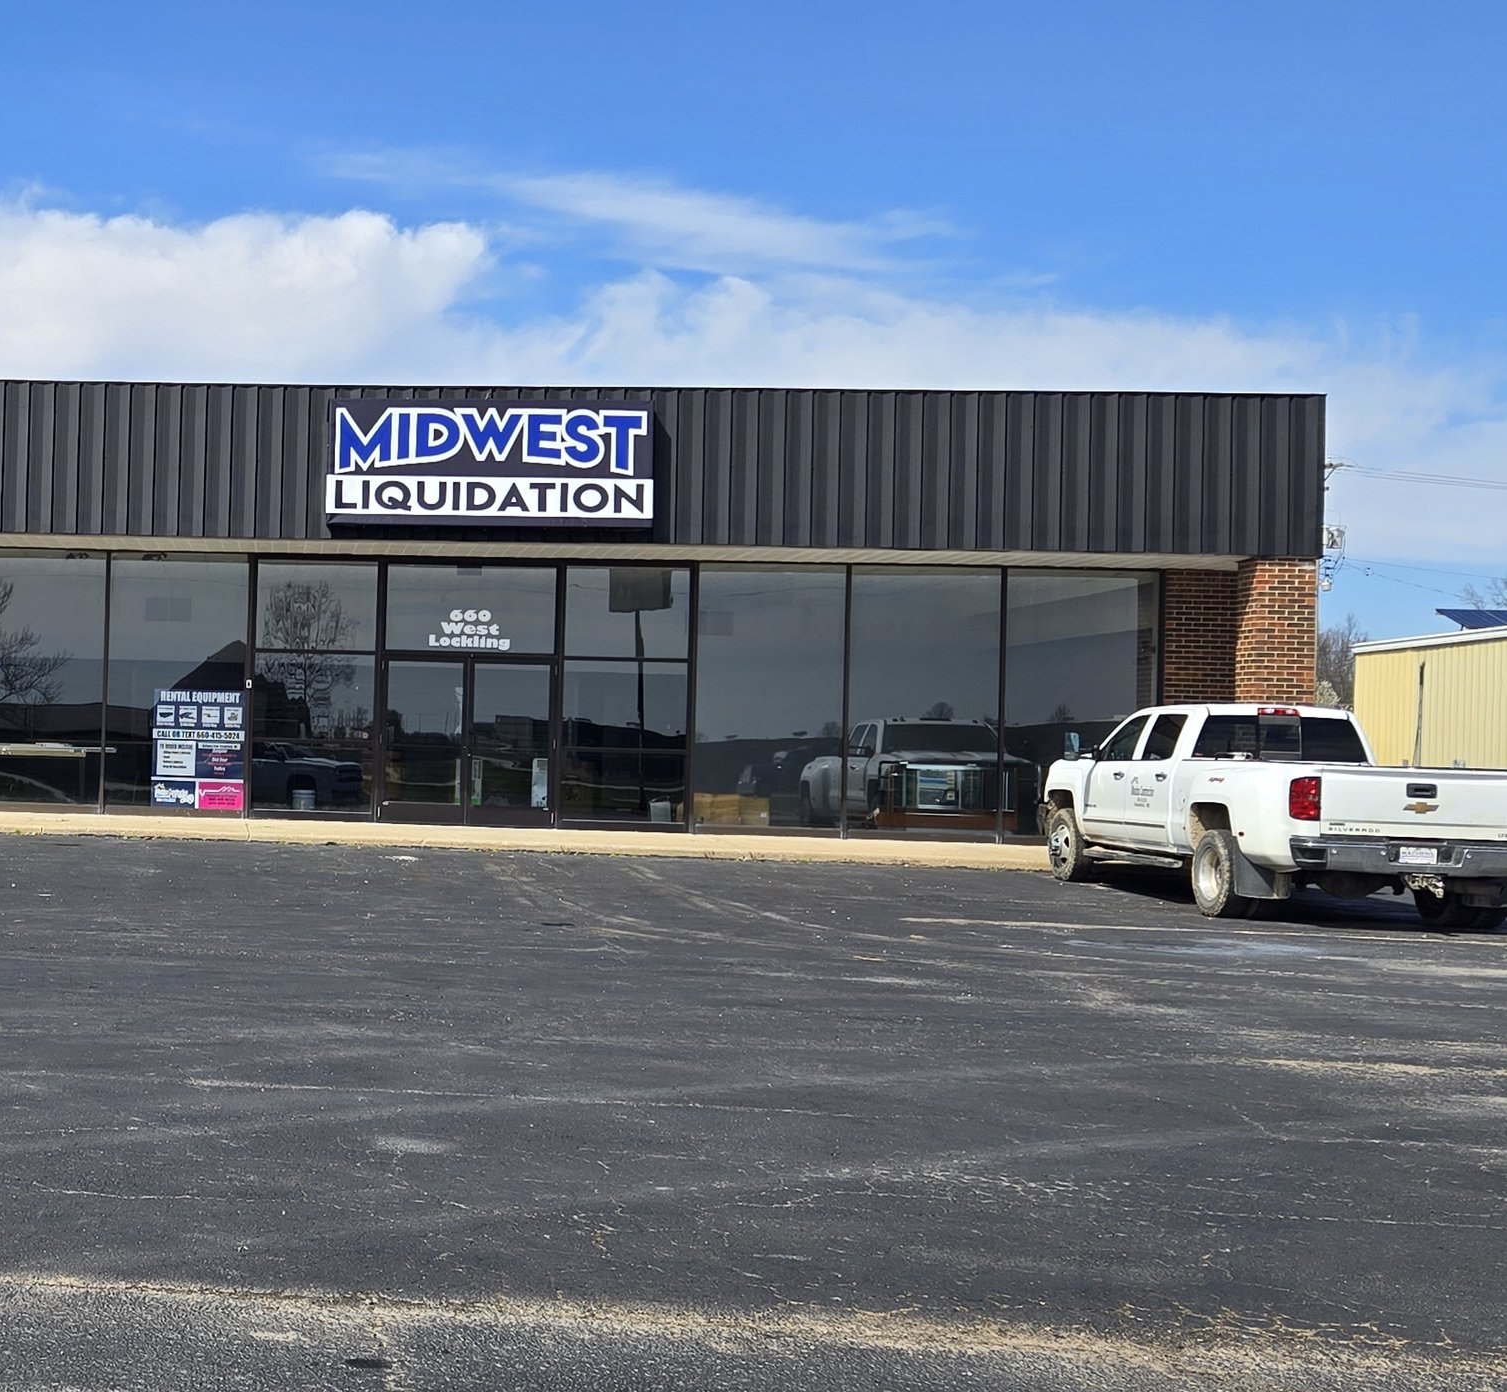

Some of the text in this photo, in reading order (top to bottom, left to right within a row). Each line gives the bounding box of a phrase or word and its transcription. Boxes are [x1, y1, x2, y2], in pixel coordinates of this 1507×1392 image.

[334, 407, 648, 476] MIDWEST
[334, 479, 645, 514] LIQUIDATION
[449, 609, 492, 622] 660
[440, 621, 500, 636] West
[428, 634, 511, 651] Lockling
[160, 690, 241, 703] RENTAL EQUIPMENT
[182, 731, 195, 739] TEXT
